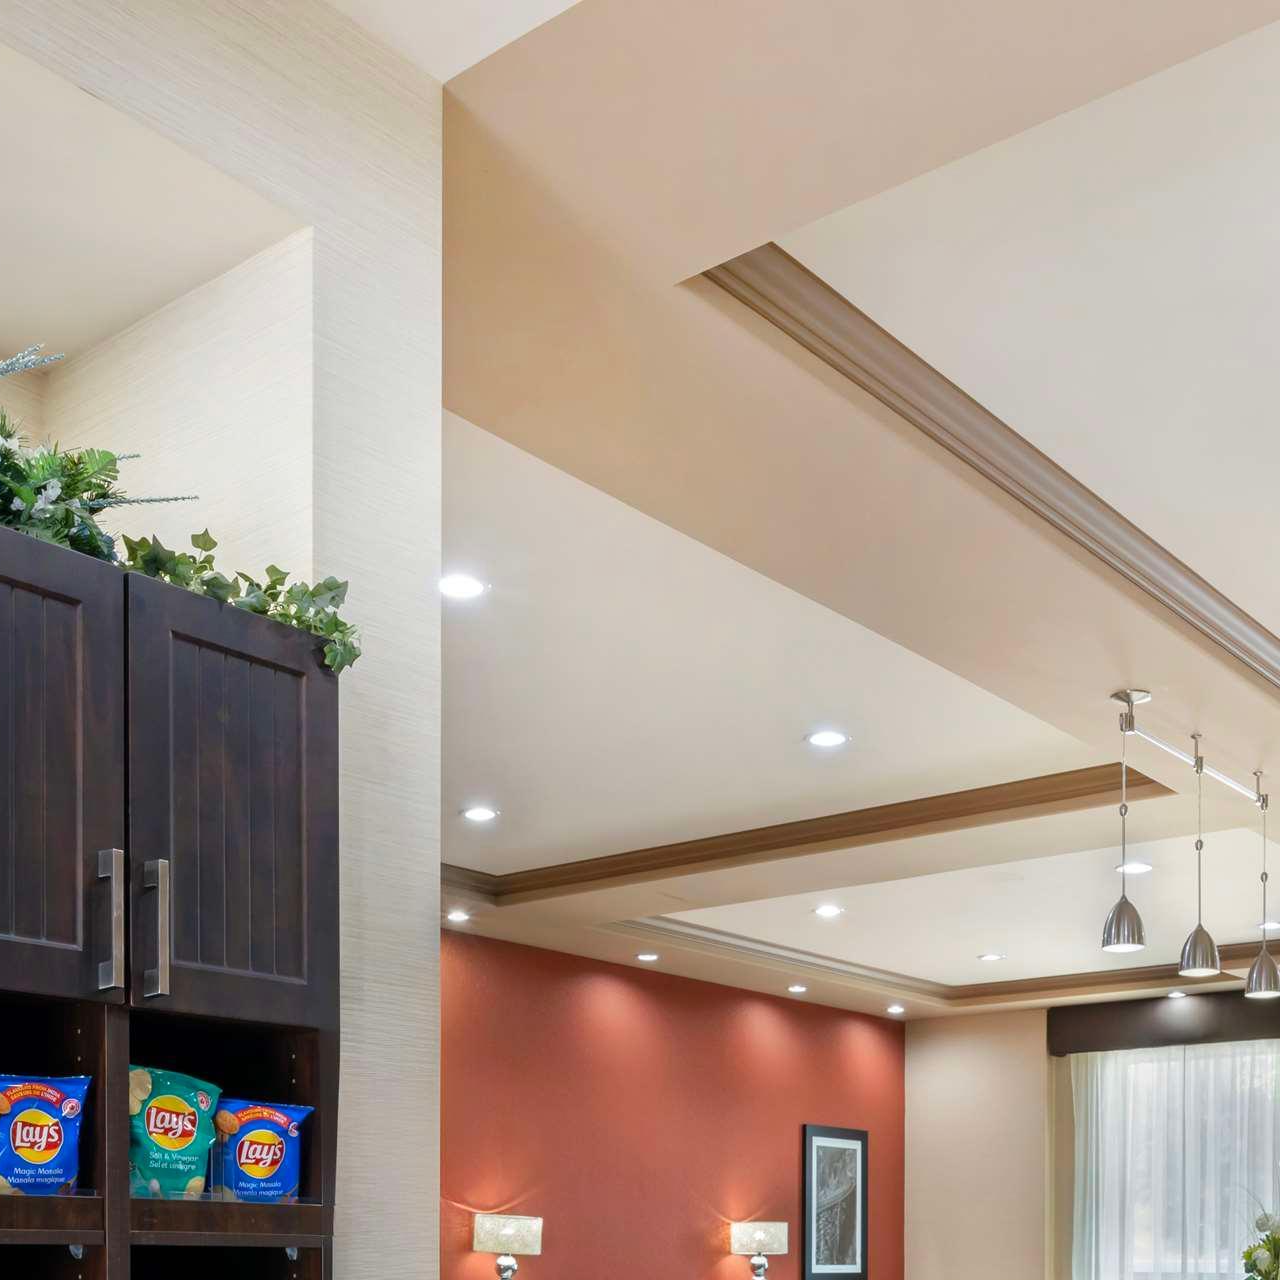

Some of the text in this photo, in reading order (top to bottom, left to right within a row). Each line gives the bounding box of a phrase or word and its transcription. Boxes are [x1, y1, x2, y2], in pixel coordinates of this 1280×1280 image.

[15, 1121, 59, 1151] Lay's
[149, 1107, 195, 1138] Lay's
[240, 1141, 282, 1168] Lay's
[7, 1176, 35, 1184] Masala
[13, 1167, 64, 1176] Magic Masala
